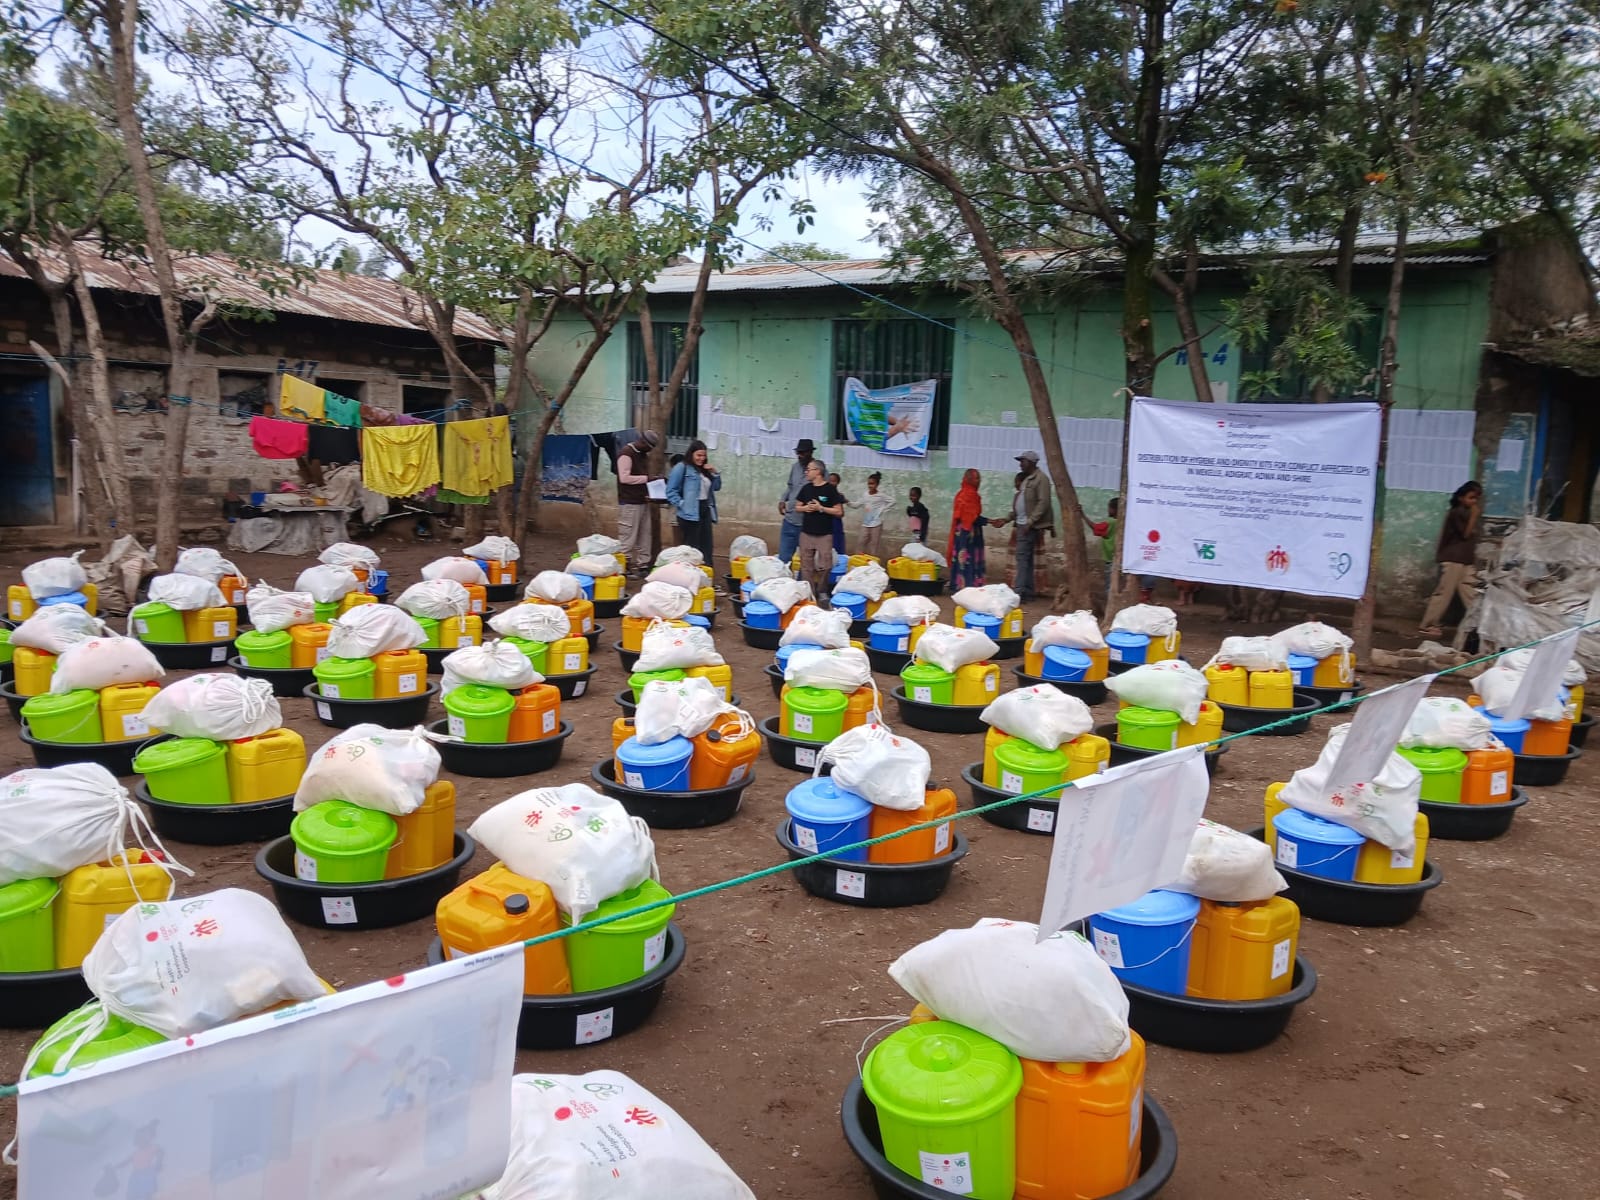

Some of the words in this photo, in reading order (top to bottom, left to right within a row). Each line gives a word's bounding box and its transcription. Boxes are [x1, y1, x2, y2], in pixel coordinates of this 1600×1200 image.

[1138, 453, 1179, 463] DISTRIBUTION
[1190, 456, 1216, 465] HYGIENE
[1216, 458, 1231, 466] AND
[1232, 459, 1258, 468] DIGNITY
[1274, 461, 1286, 469] FOR
[1287, 462, 1320, 471] CONFLICT
[1320, 464, 1353, 473] AFFECTED
[1276, 473, 1290, 481] AND
[1291, 474, 1312, 483] SHIRE
